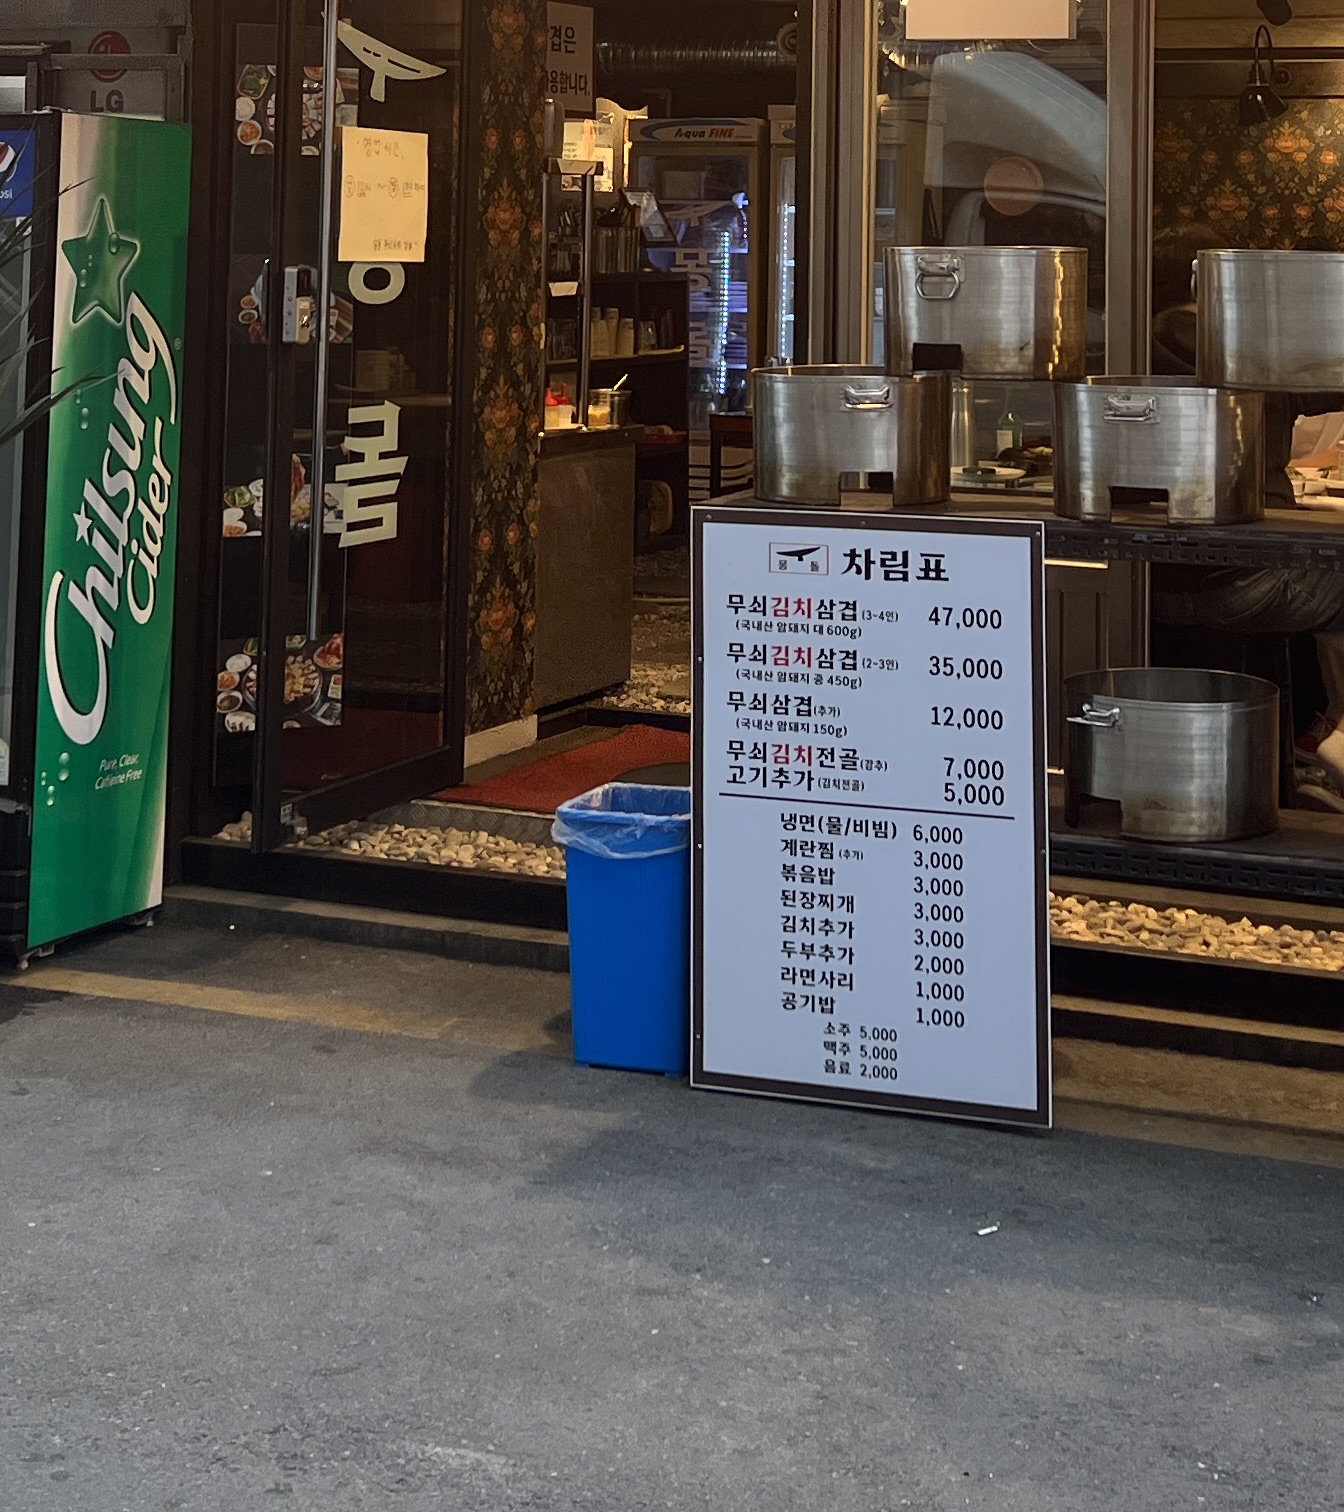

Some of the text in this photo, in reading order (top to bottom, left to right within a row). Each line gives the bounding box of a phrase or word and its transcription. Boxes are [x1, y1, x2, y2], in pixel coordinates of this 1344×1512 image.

[547, 24, 577, 55] 겹은
[90, 90, 124, 113] LG
[674, 128, 735, 138] Aqua FINE
[45, 292, 176, 746] Chilsung
[127, 416, 171, 625] Cider
[841, 548, 949, 582] 차림표
[726, 594, 857, 623] 무쇠김치삼겹
[928, 606, 1002, 630] 47,000
[826, 625, 862, 639] 600g)
[726, 642, 857, 672] 무쇠김치삼겹
[929, 656, 1002, 680] 35,000
[827, 675, 863, 690] 450g)
[813, 723, 847, 738] 150g)
[931, 706, 1003, 730] 12,000
[726, 740, 859, 770] 무쇠김치전골
[944, 757, 1004, 781] 7,000
[726, 766, 814, 791] 고기추가
[944, 783, 1005, 806] 5,000
[780, 813, 963, 845] 냉면(물/비빔) 6,000
[780, 839, 834, 859] 계란찜
[914, 850, 963, 871] 3,000
[780, 863, 963, 897] 볶음밥 3,000
[780, 890, 963, 923] 된장찌개 3,000
[781, 915, 964, 949] 김치추가 3,000
[781, 939, 964, 976] 두부추가 2,000
[781, 967, 964, 1002] 라면사리 1,000
[781, 992, 964, 1028] 공기밥 1,000
[824, 1022, 897, 1042] 소주 5,000
[823, 1041, 897, 1061] 맥주 5,000
[824, 1059, 897, 1080] 음료 2,000
